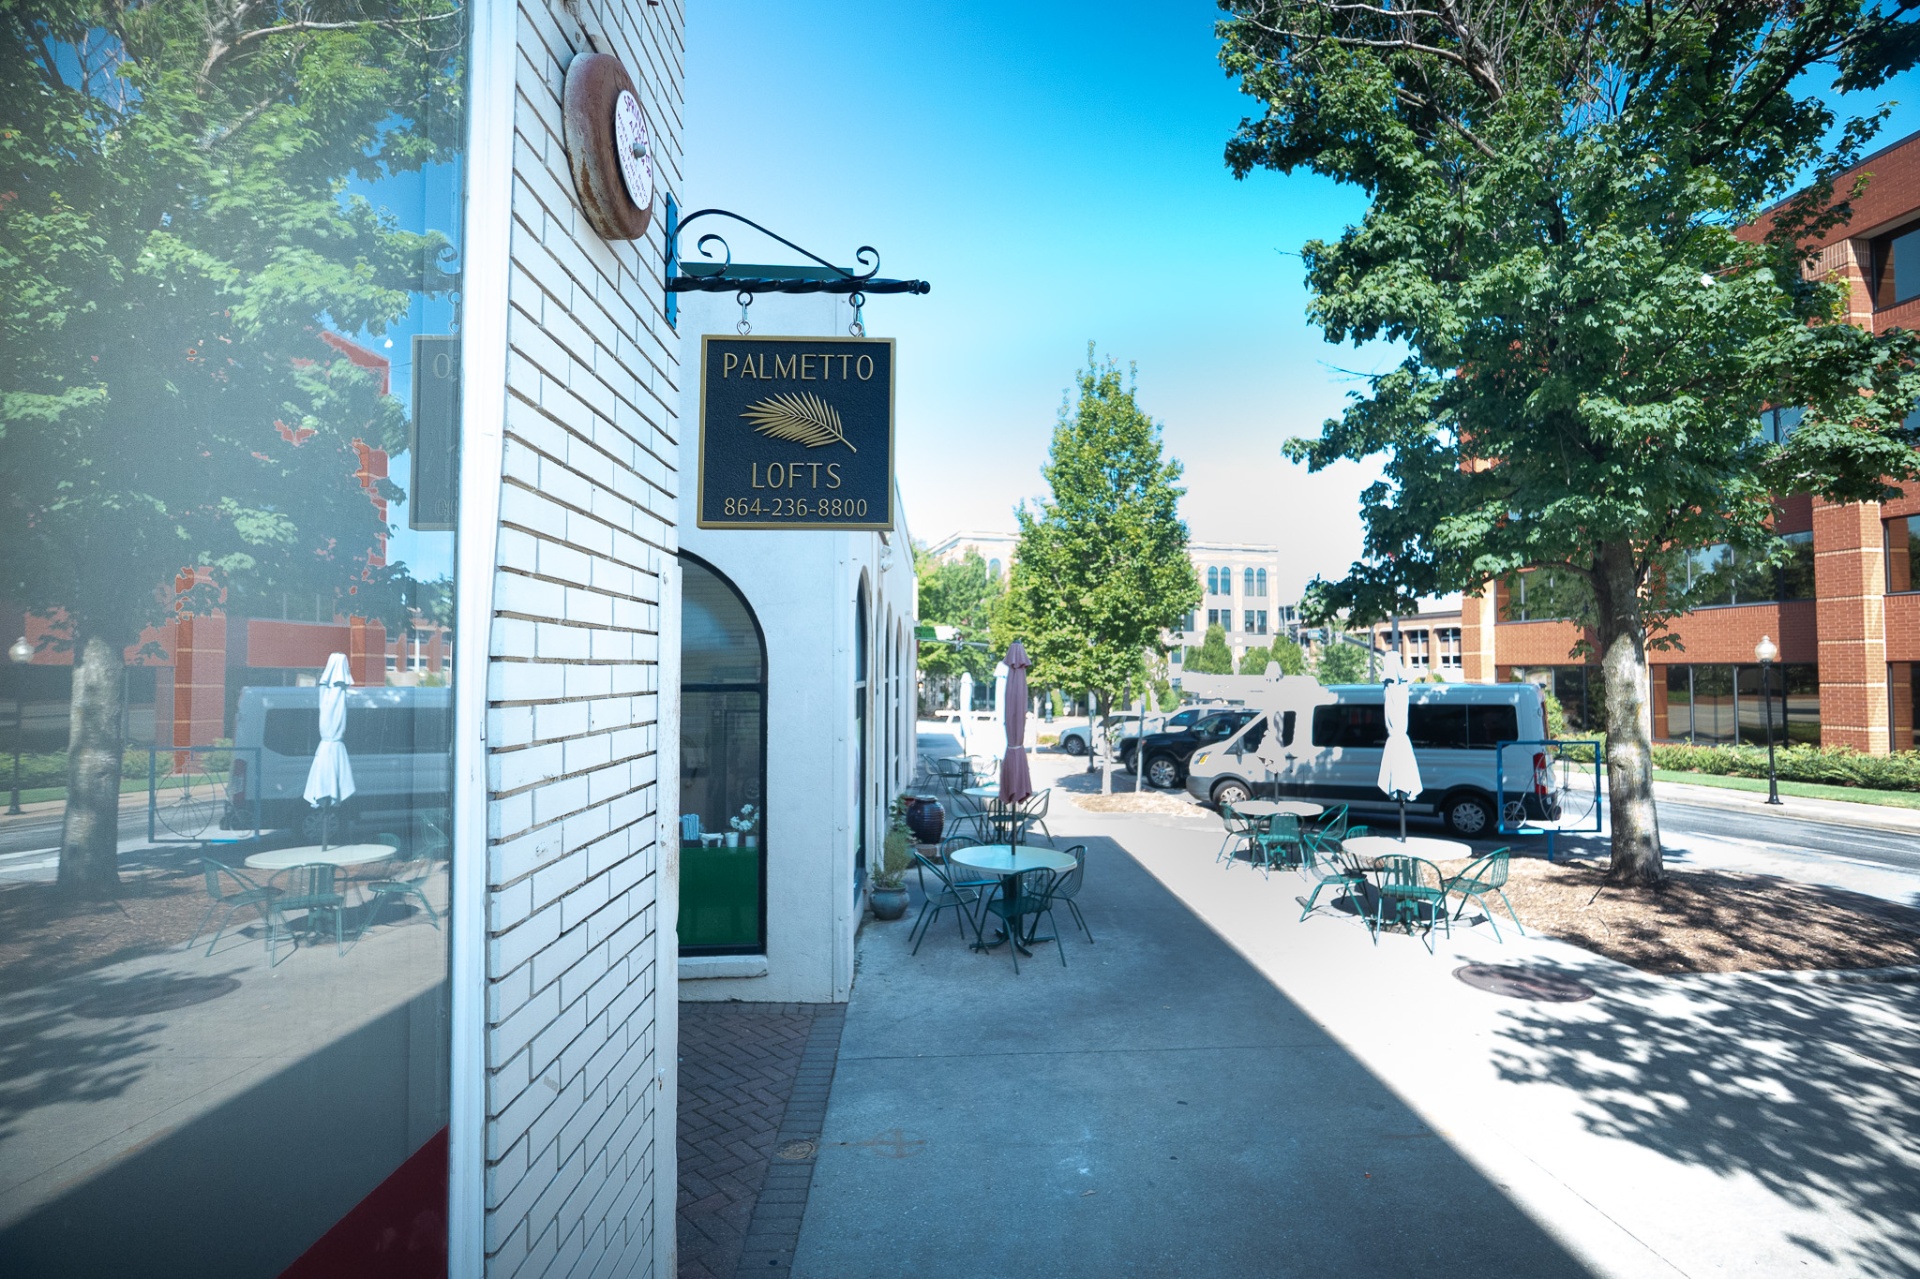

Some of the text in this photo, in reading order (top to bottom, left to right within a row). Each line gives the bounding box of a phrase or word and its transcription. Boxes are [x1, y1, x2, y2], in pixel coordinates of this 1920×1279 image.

[723, 352, 874, 381] PALMETTO
[752, 462, 841, 489] LOFTS
[724, 497, 868, 517] 864-236-8800
